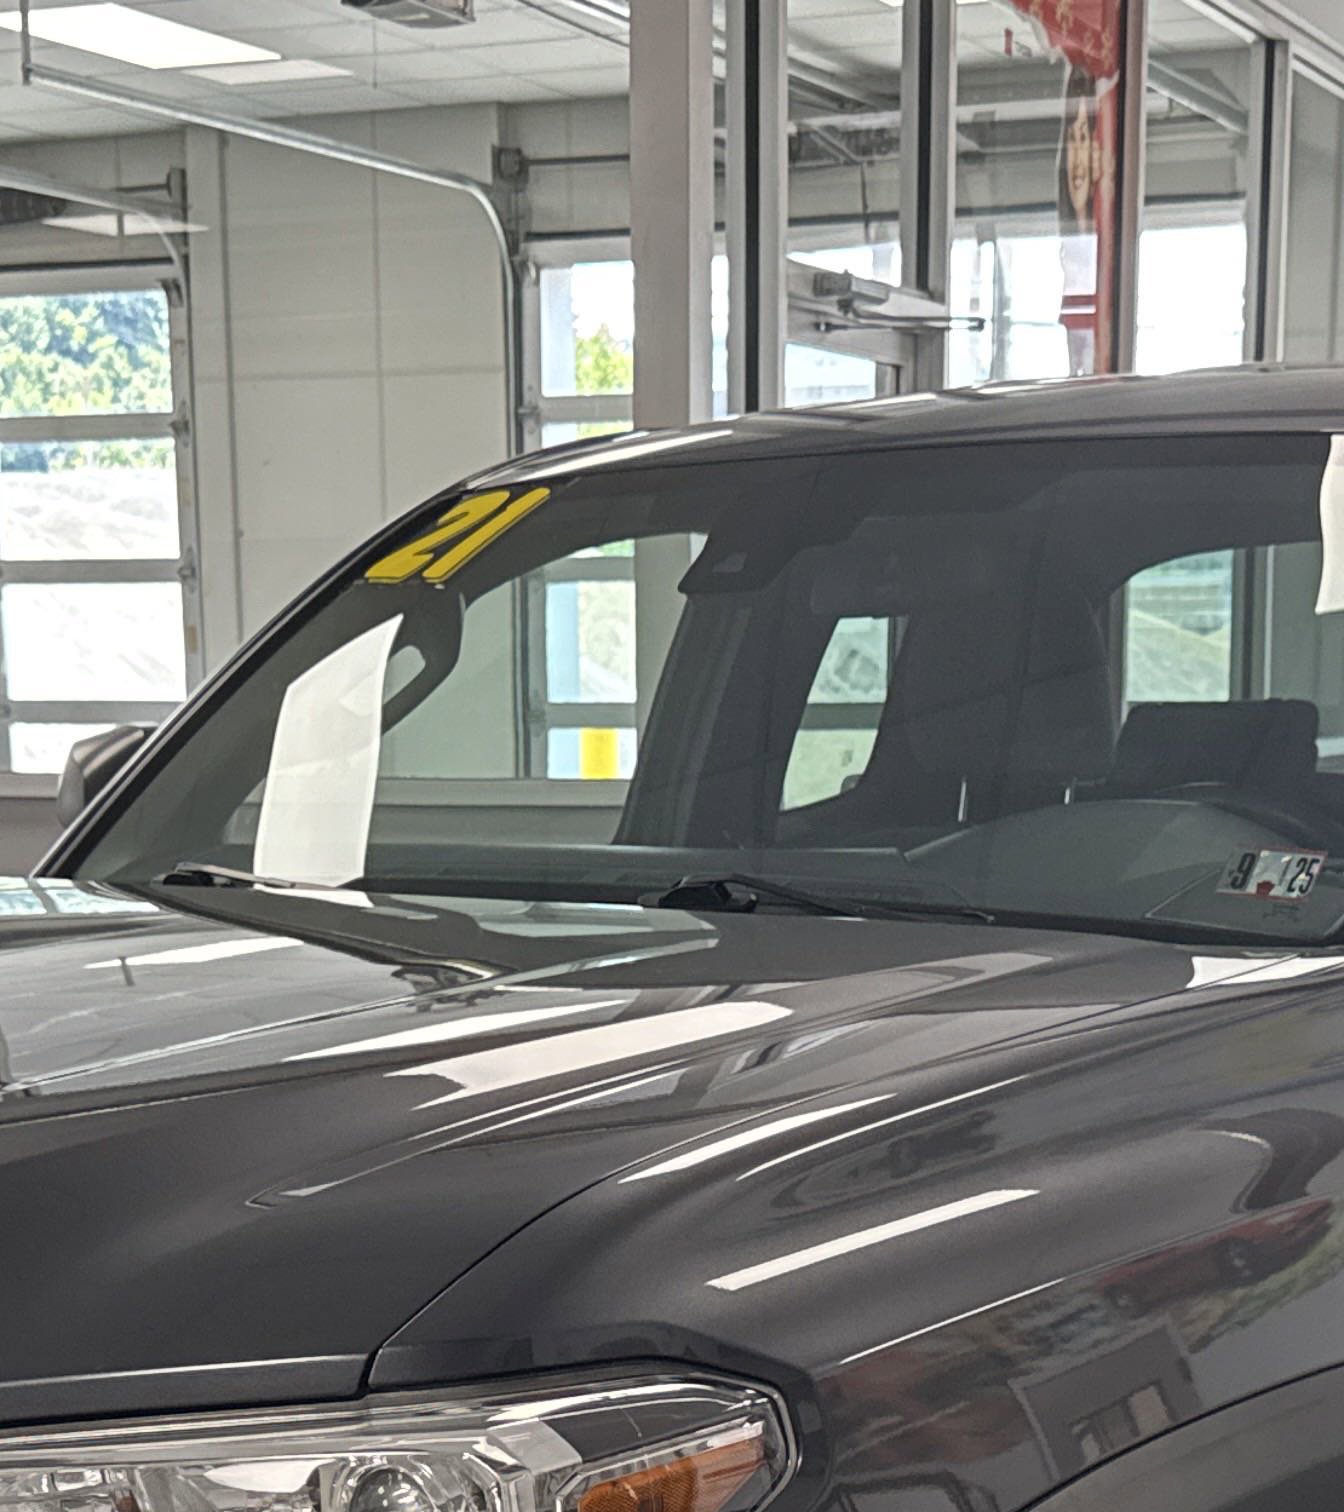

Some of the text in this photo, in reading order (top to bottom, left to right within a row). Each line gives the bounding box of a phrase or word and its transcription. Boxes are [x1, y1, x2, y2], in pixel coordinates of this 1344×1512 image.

[364, 487, 551, 584] 21
[1229, 852, 1321, 895] 9 25
